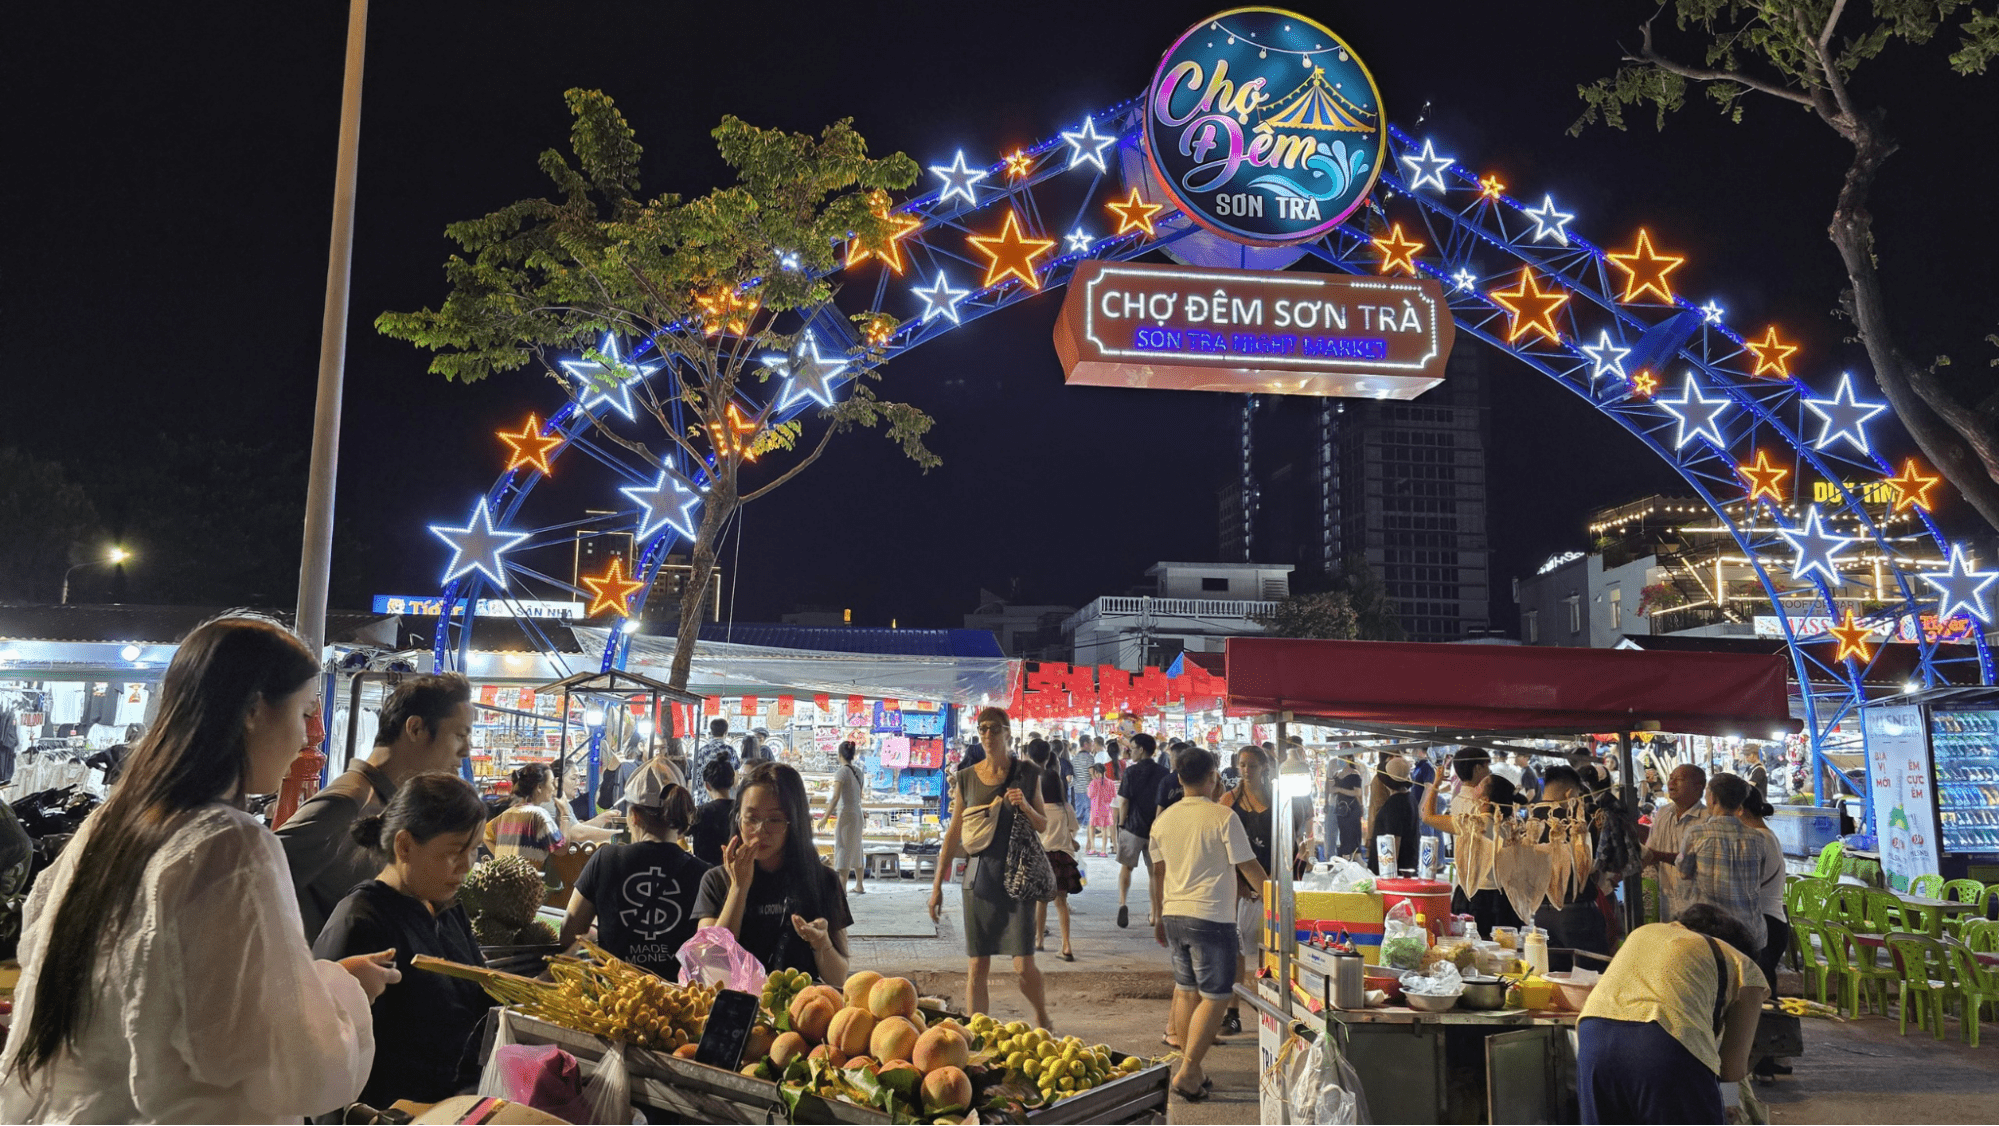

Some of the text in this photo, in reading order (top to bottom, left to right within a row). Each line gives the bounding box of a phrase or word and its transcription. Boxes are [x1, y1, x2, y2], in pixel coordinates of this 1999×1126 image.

[1154, 59, 1269, 126] Chợ
[1178, 114, 1317, 192] Đêm
[1215, 192, 1263, 218] SƠN
[1101, 289, 1423, 333] CHỢ ĐÊM SƠN TRÀ
[1136, 329, 1385, 360] SON TRA NIGHT MARKET
[624, 953, 677, 965] MONEY
[629, 944, 669, 955] MADE
